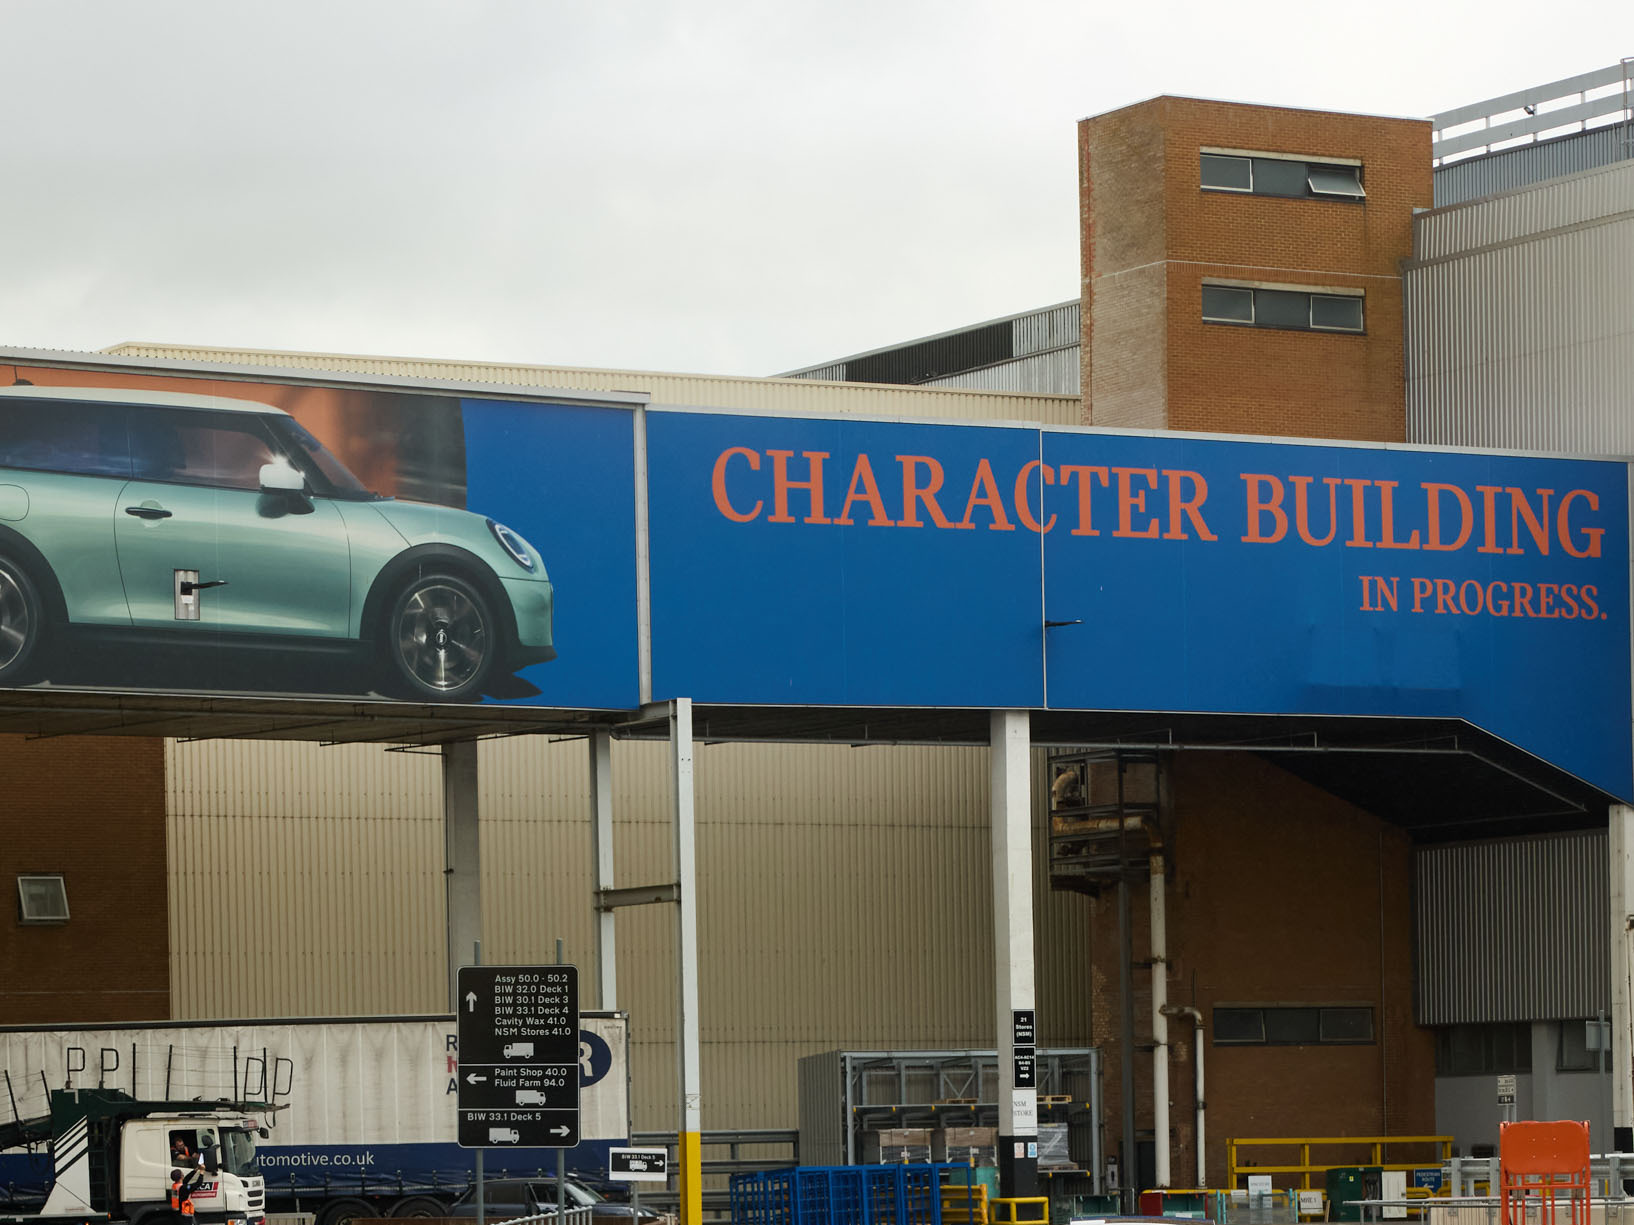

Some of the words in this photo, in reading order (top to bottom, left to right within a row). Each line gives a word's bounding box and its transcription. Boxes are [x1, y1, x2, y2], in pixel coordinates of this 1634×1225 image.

[712, 446, 1219, 542] CHARACTER
[1240, 473, 1606, 559] BUILDING
[1358, 576, 1400, 612] IN
[1410, 577, 1608, 620] PROGRESS.
[495, 974, 516, 984] Assy
[518, 974, 540, 983] 50.0
[547, 974, 568, 983] 50.2
[494, 985, 514, 993] BIW
[516, 985, 537, 993] 32.0
[540, 985, 562, 993] Deck
[564, 985, 568, 993] 1
[494, 996, 514, 1004] BIW
[516, 996, 535, 1004] 30.1
[538, 996, 561, 1004] Deck
[562, 996, 569, 1004] 3
[494, 1006, 514, 1015] BIW
[516, 1006, 535, 1015] 33.1
[538, 1006, 561, 1015] Deck
[562, 1006, 569, 1014] 4
[495, 1017, 523, 1026] Cavity
[526, 1017, 545, 1025] Wax
[547, 1017, 566, 1025] 41.0
[495, 1027, 518, 1036] NSM
[521, 1027, 550, 1036] Stores
[551, 1027, 571, 1036] 41.0
[494, 1068, 517, 1076] Paint
[520, 1068, 543, 1077] Shop
[545, 1068, 567, 1076] 40.0
[494, 1079, 516, 1087] Fluid
[519, 1079, 541, 1087] Farm
[543, 1079, 565, 1087] 94.0
[467, 1112, 486, 1121] BIW
[489, 1112, 507, 1121] 33.1
[510, 1112, 533, 1121] Deck
[535, 1112, 541, 1121] 5
